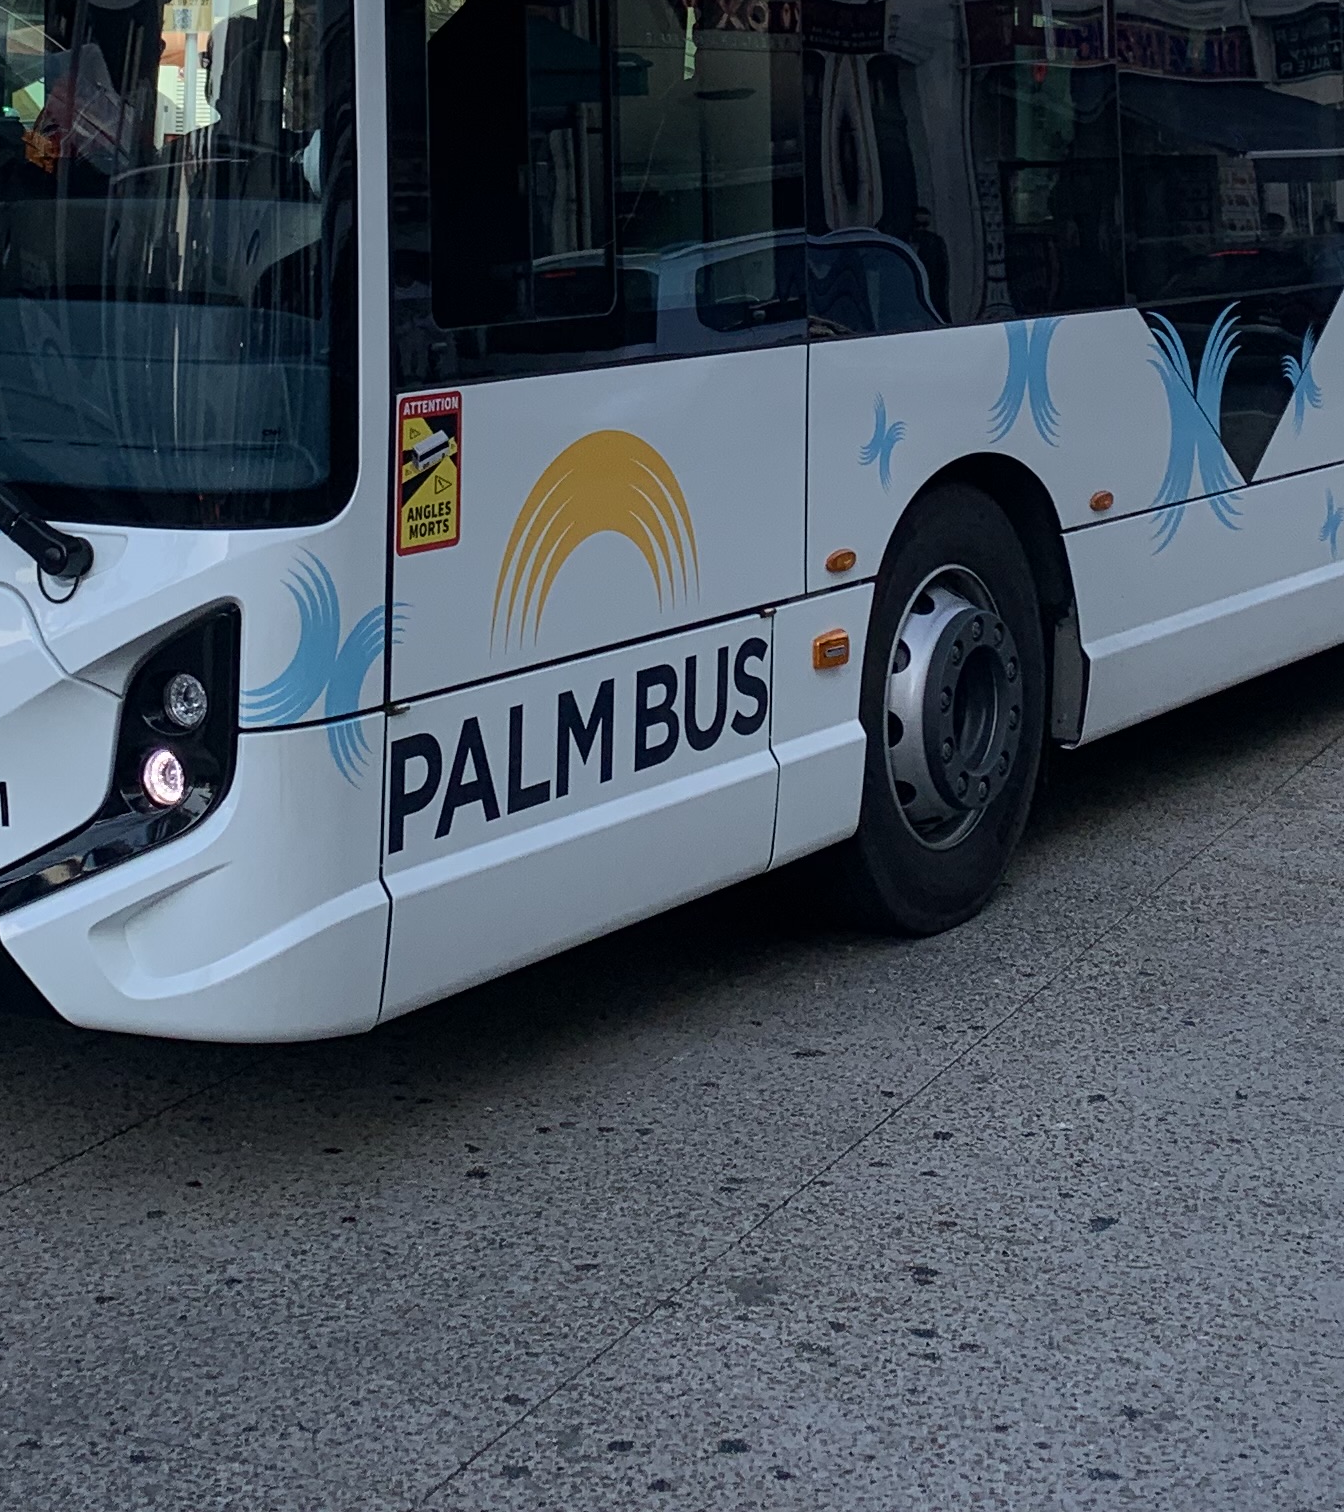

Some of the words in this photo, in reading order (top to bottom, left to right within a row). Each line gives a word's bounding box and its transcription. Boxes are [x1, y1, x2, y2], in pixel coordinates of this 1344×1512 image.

[403, 396, 459, 416] ATTENTION
[407, 501, 452, 523] ANGLES
[409, 518, 449, 540] MORTS
[388, 678, 615, 855] PALM
[634, 637, 769, 772] BUS
